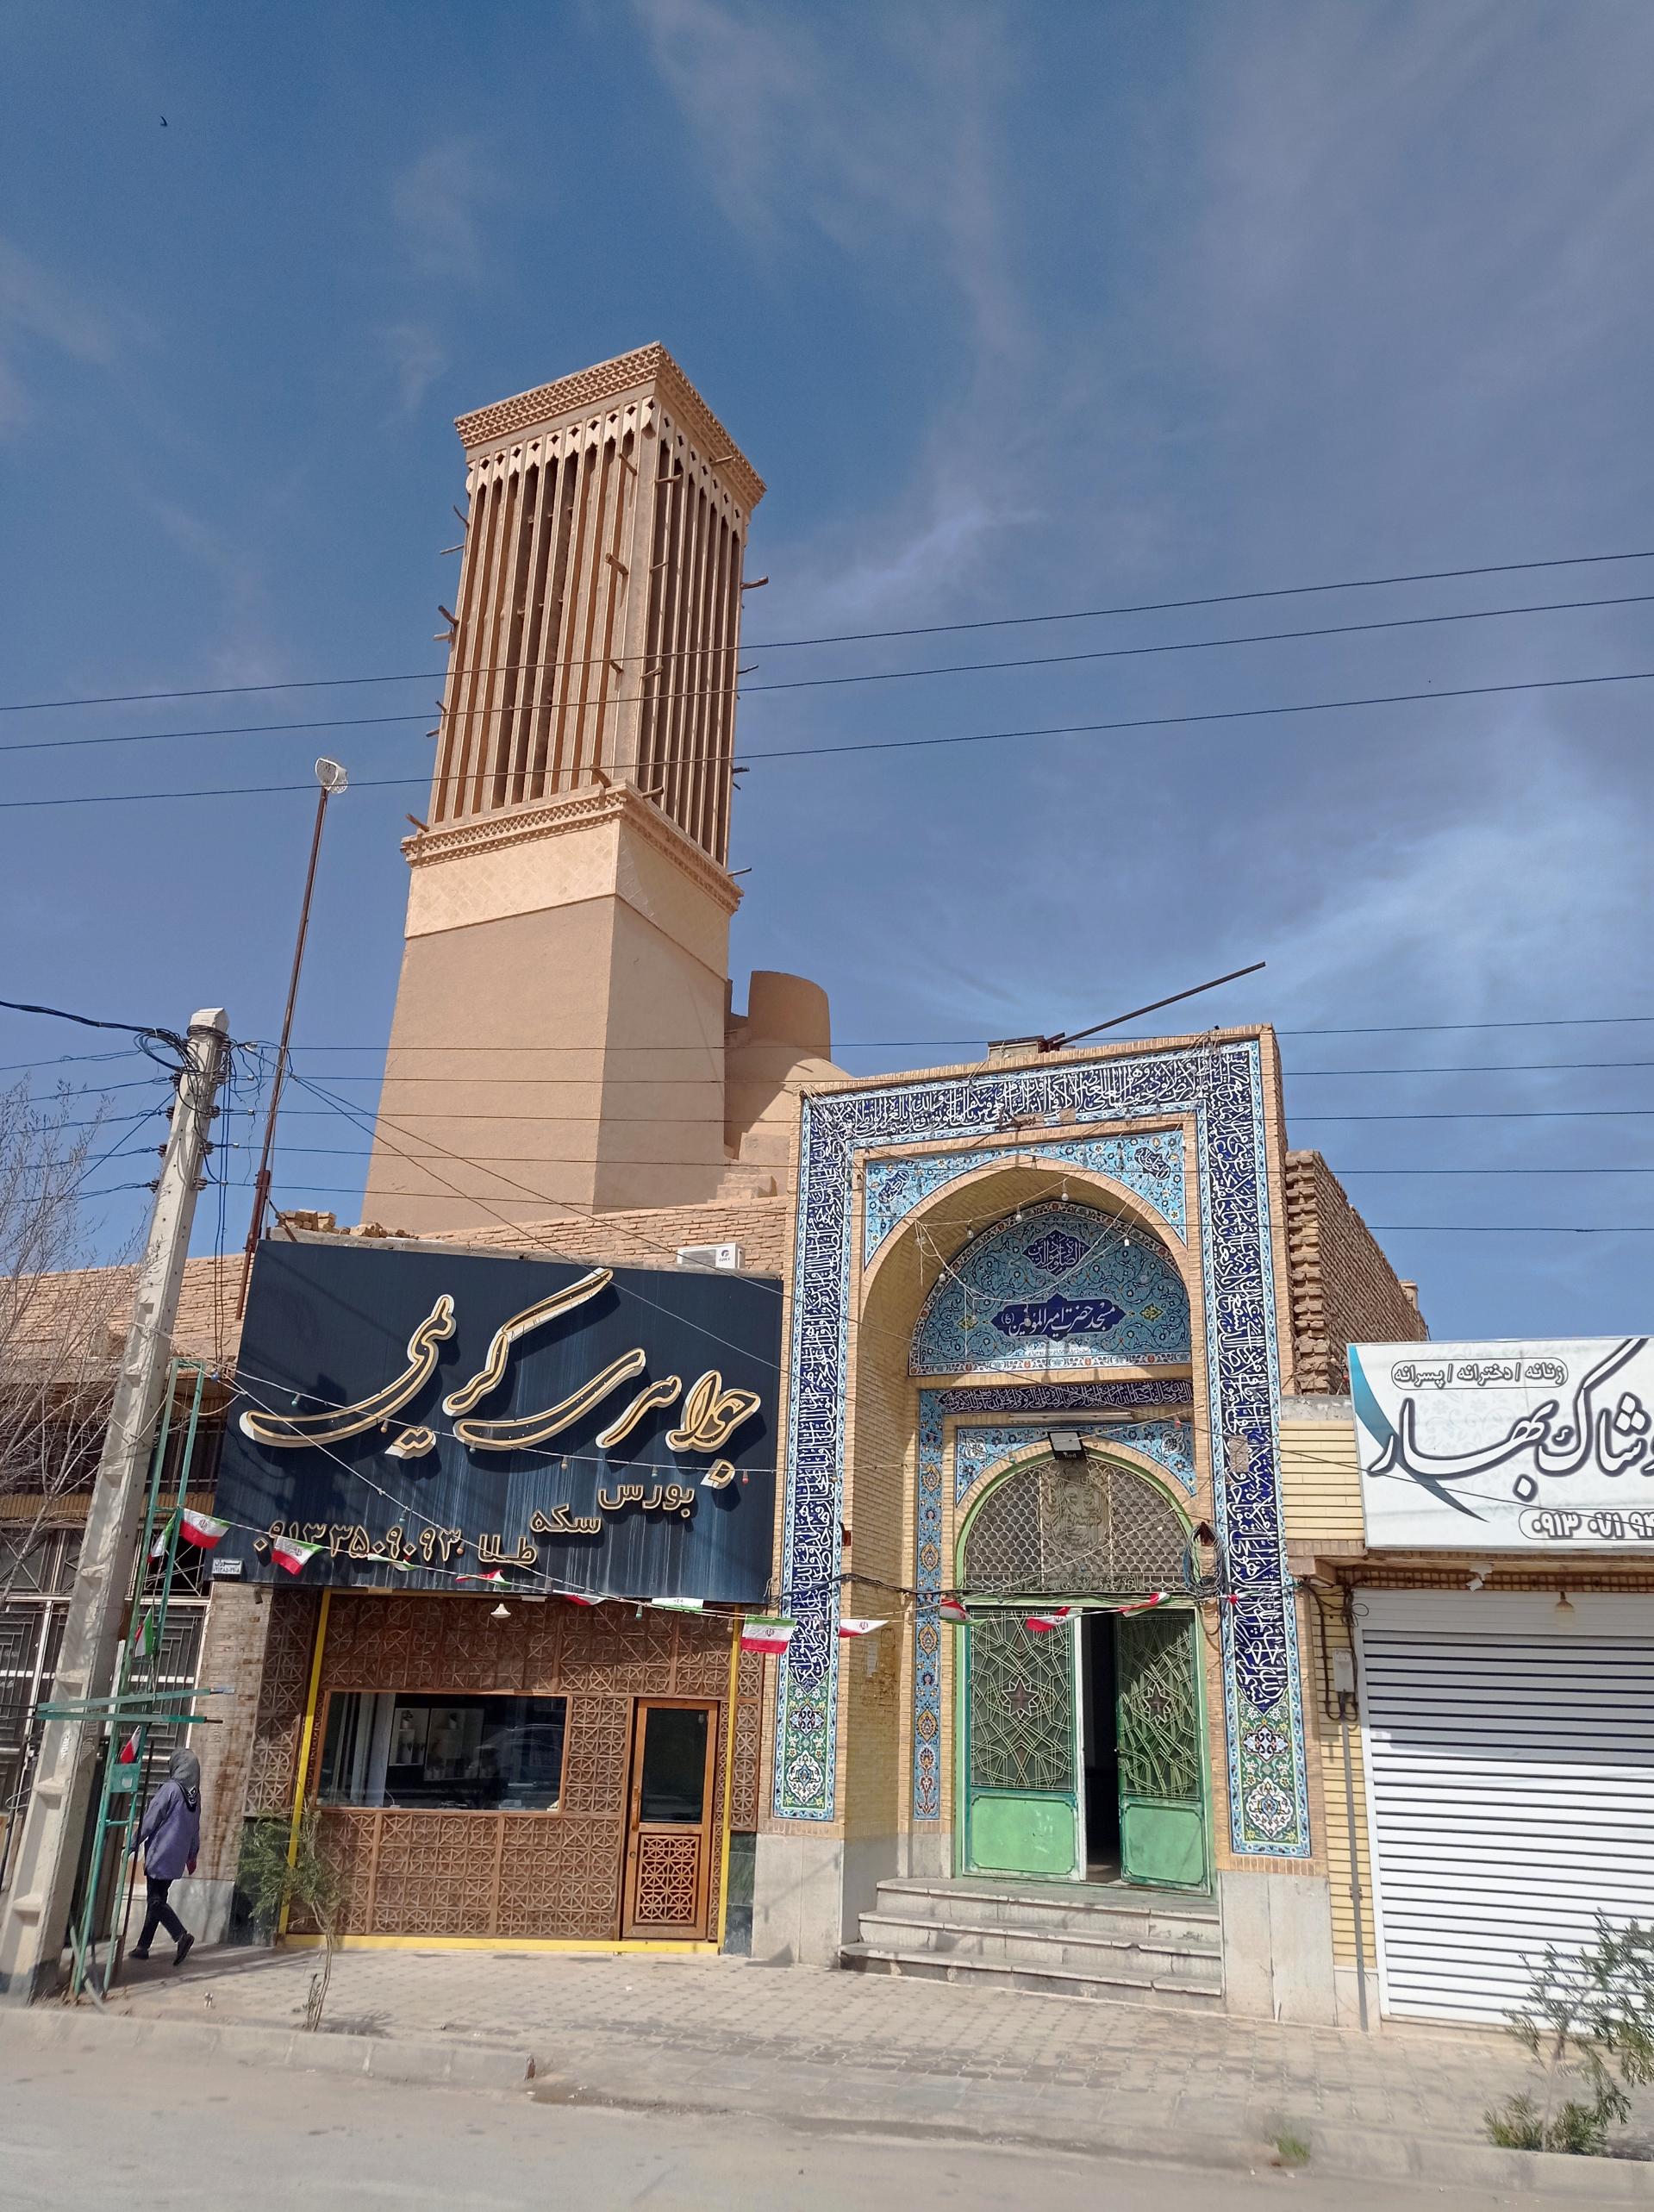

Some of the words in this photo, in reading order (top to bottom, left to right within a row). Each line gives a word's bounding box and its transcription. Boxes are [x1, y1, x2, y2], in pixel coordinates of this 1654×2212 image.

[1051, 1304, 1095, 1333] حضرت
[1083, 1302, 1116, 1331] مسجد
[1393, 1364, 1446, 1390] پسرانه
[1457, 1363, 1514, 1386] دخترانه
[1525, 1361, 1566, 1385] زنانه
[1366, 1397, 1560, 1503] بهار
[597, 1482, 696, 1518] بورس
[528, 1503, 602, 1534] سکه
[1531, 1511, 1583, 1539] ۰۹۱۳
[477, 1533, 539, 1565] طلا
